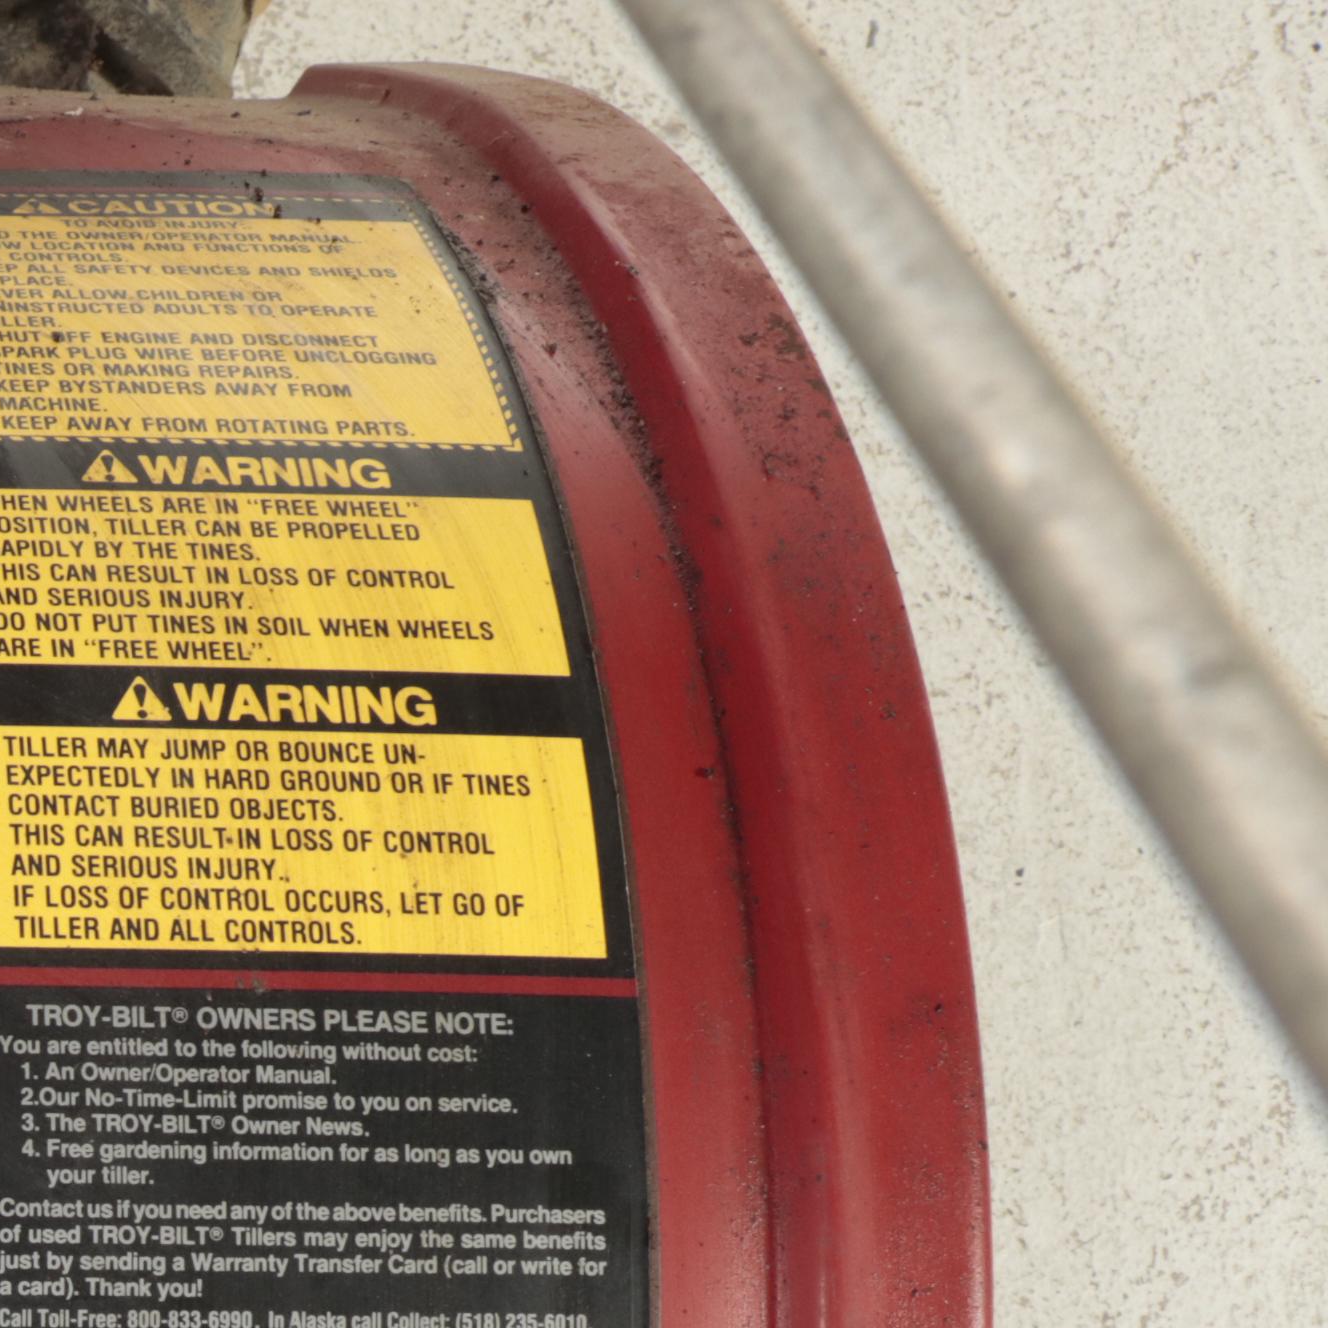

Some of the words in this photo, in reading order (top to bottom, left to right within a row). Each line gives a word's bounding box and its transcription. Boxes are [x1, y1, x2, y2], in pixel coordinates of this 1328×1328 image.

[68, 200, 273, 216] CAUTION
[2, 416, 57, 430] KEEP
[68, 417, 131, 431] AWAY
[142, 417, 207, 432] FROM
[216, 419, 328, 434] ROTATING
[336, 421, 414, 436] PARTS.
[137, 455, 391, 489] WARNING
[48, 588, 150, 608] SERIOUS
[160, 590, 252, 609] INJURY.
[173, 683, 437, 726] WARNING
[8, 794, 120, 816] CONTACT
[131, 796, 218, 818] BURIED
[230, 798, 342, 821] OBJECTS.
[14, 916, 99, 939] TILLER
[110, 918, 159, 940] AND
[170, 919, 214, 942] ALL
[225, 920, 361, 944] CONTROLS.
[197, 1007, 316, 1031] OWNERS
[324, 1010, 428, 1033] PLEASE
[436, 1012, 513, 1035] NOTE:
